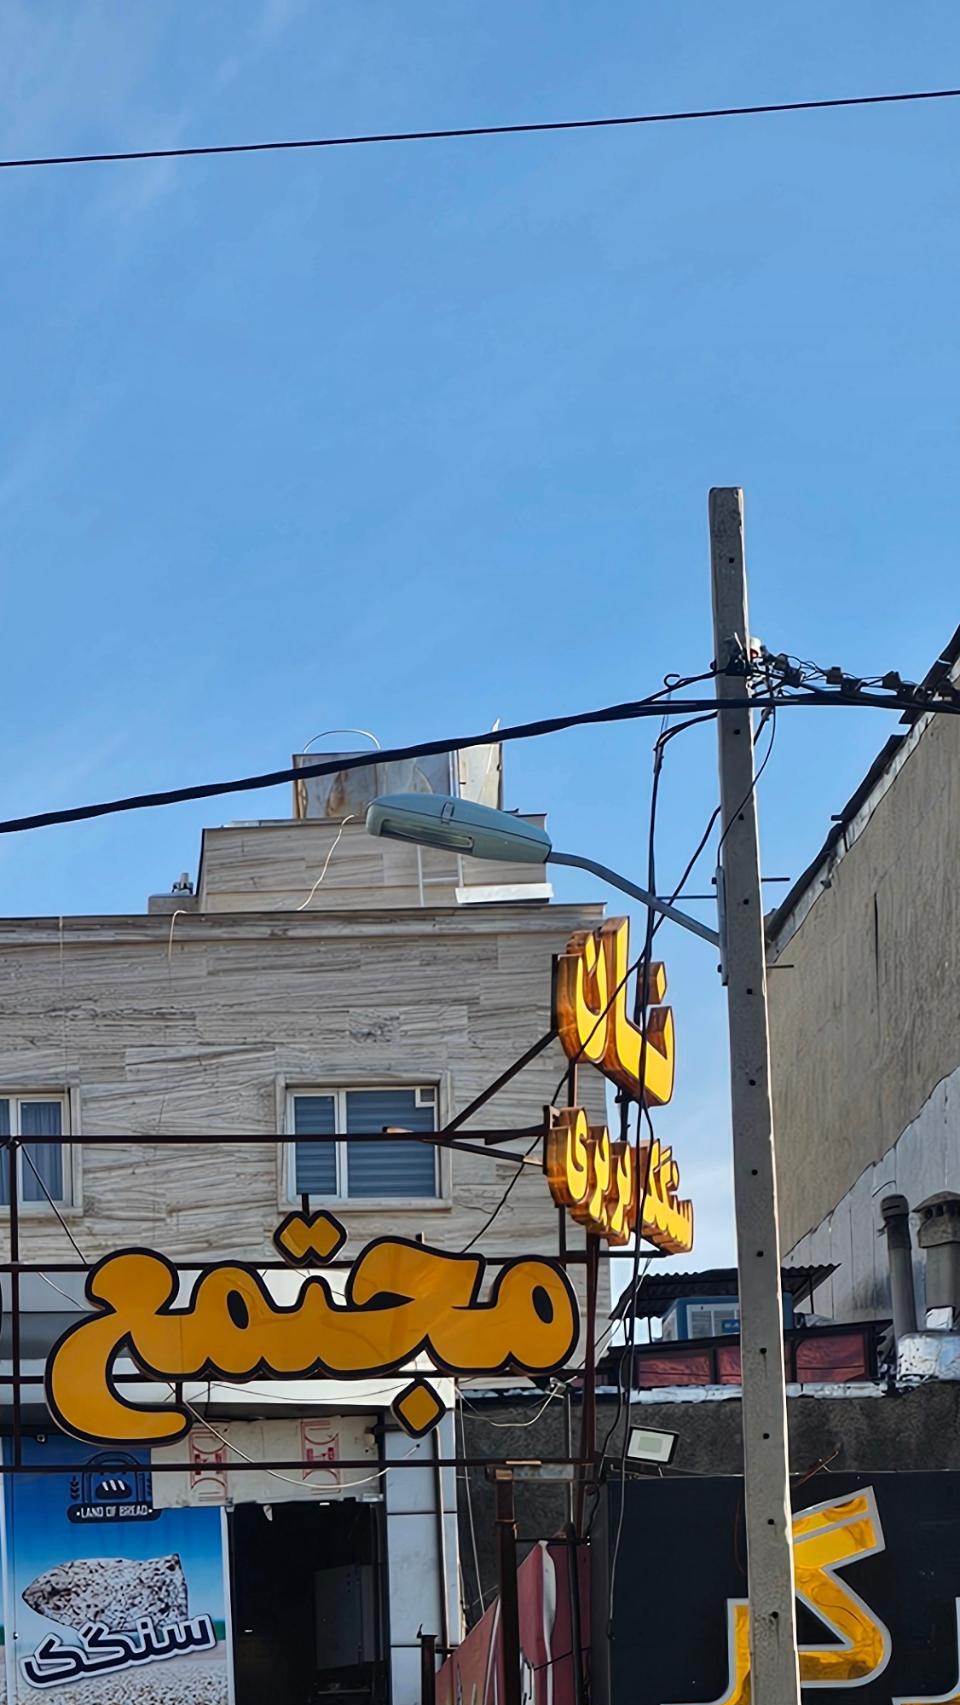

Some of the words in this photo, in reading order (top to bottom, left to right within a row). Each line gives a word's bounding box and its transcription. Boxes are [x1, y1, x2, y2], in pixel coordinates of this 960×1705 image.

[559, 916, 675, 1106] نان
[45, 1209, 581, 1447] مجتمع
[81, 1506, 103, 1518] LAND
[106, 1506, 116, 1517] OF
[21, 1613, 218, 1688] سنگک
